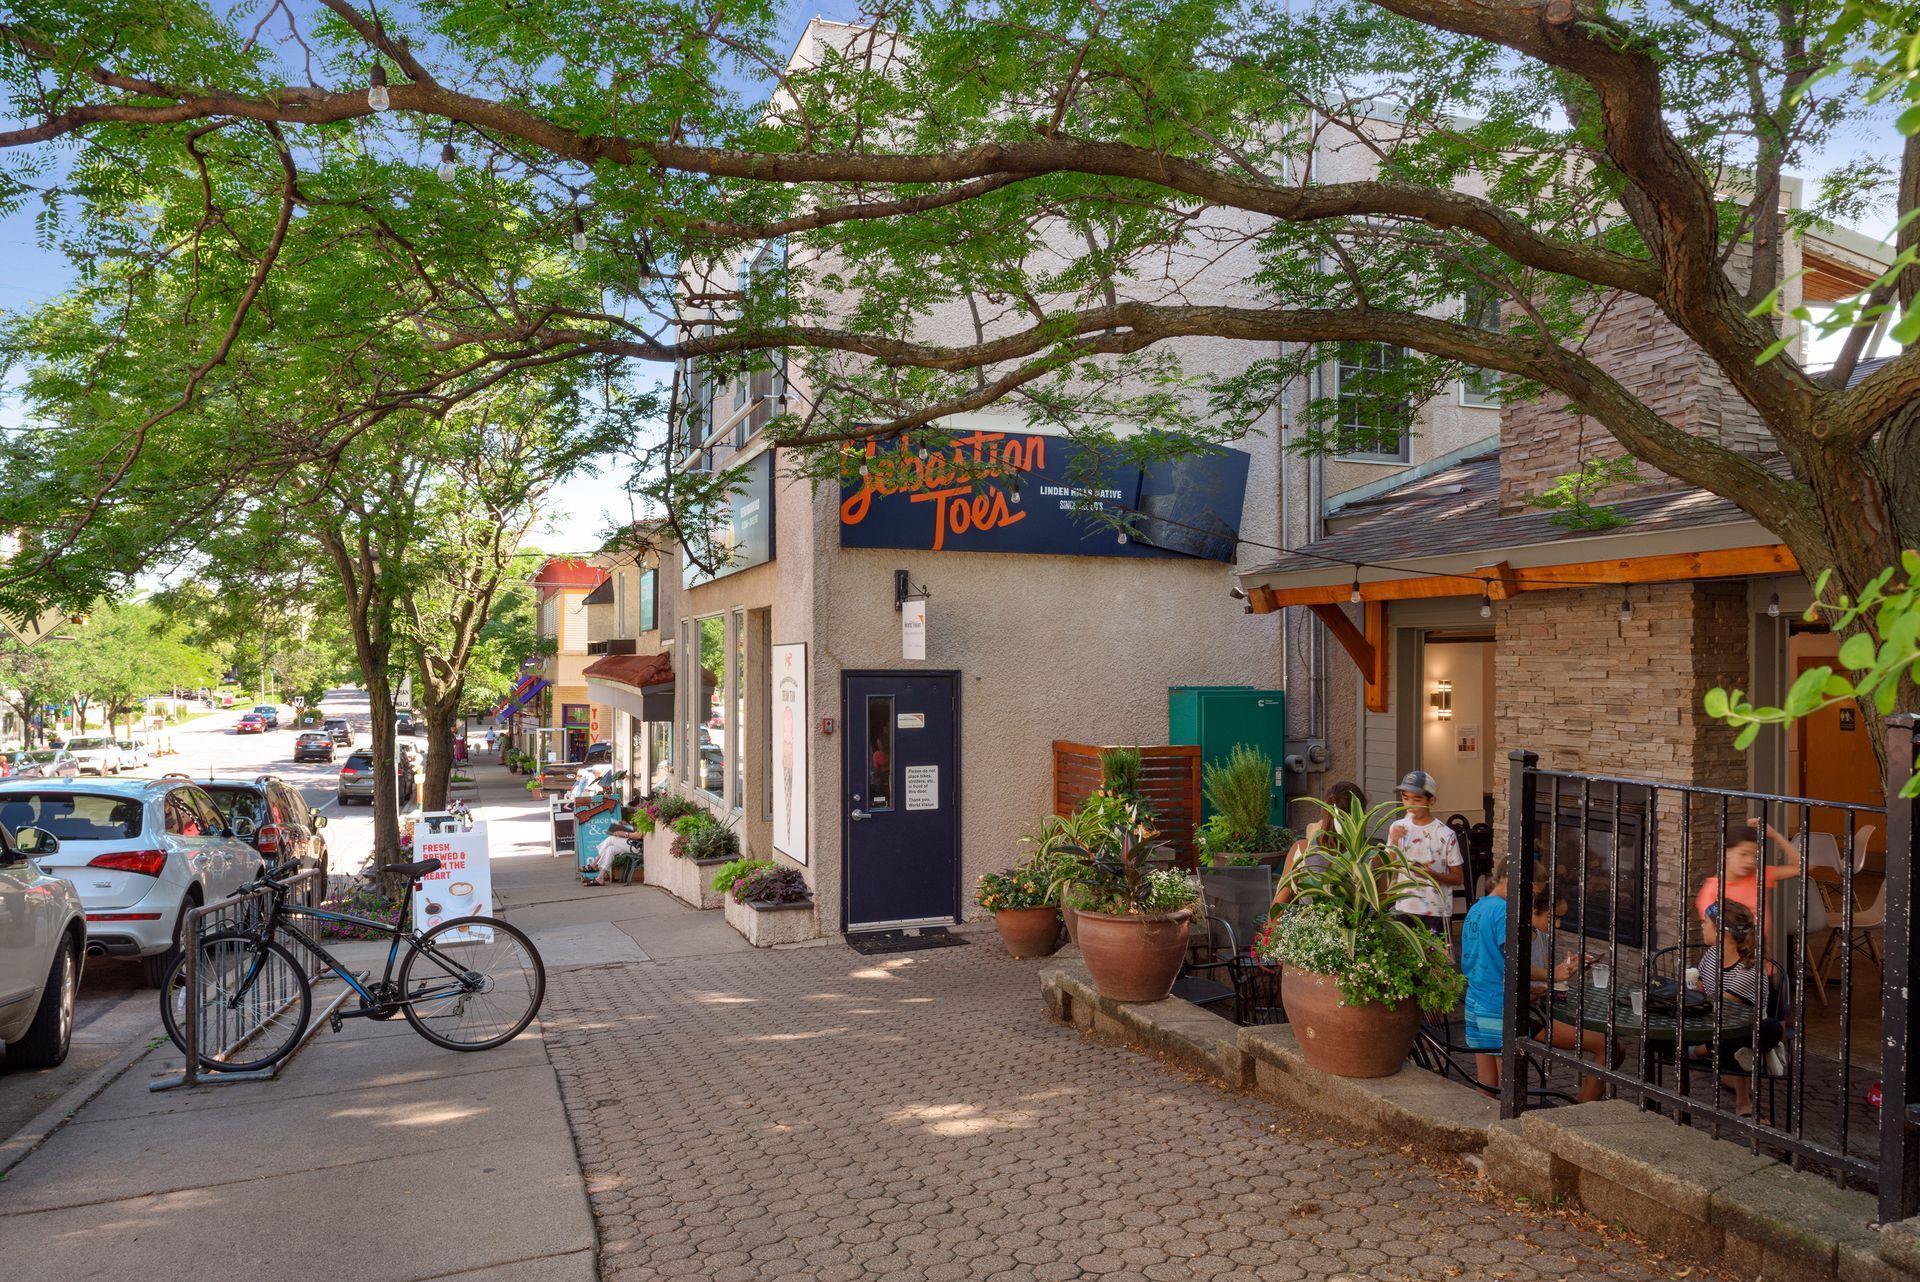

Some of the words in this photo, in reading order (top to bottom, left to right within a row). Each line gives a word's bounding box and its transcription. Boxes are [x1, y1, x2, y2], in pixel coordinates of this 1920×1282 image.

[1040, 486, 1069, 496] LINDEN
[423, 843, 450, 852] FRESH
[423, 852, 458, 860] BREWED
[449, 861, 465, 869] THE
[424, 872, 451, 880] HEART
